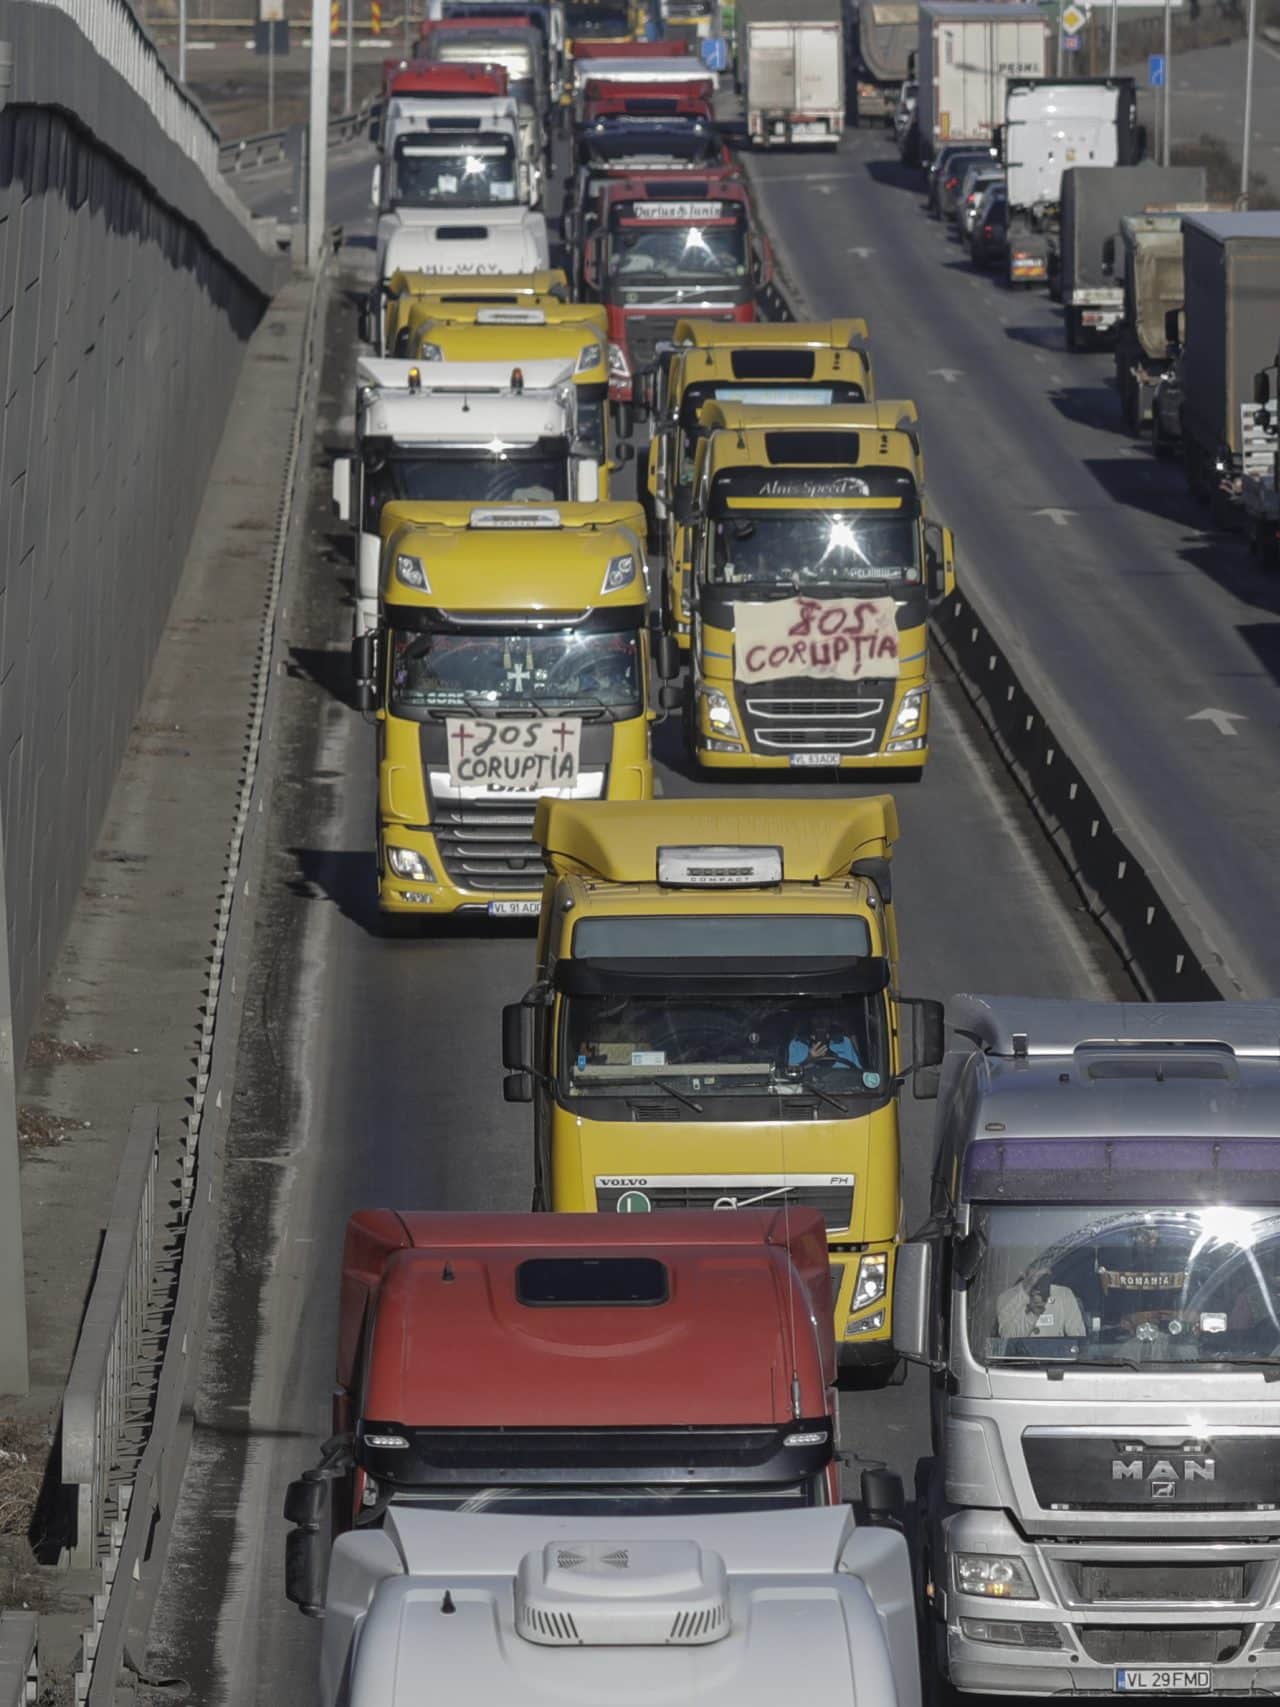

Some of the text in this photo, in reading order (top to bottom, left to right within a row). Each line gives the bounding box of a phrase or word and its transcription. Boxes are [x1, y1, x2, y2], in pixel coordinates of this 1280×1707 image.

[472, 721, 543, 757] JOS
[494, 903, 507, 913] VL
[510, 903, 519, 913] 91
[600, 1178, 648, 1187] VOLVO
[830, 1176, 849, 1185] FH
[1120, 1275, 1169, 1286] ROMANIA
[1111, 1459, 1216, 1481] MAN
[1127, 1671, 1210, 1688] VL 29 FMD
